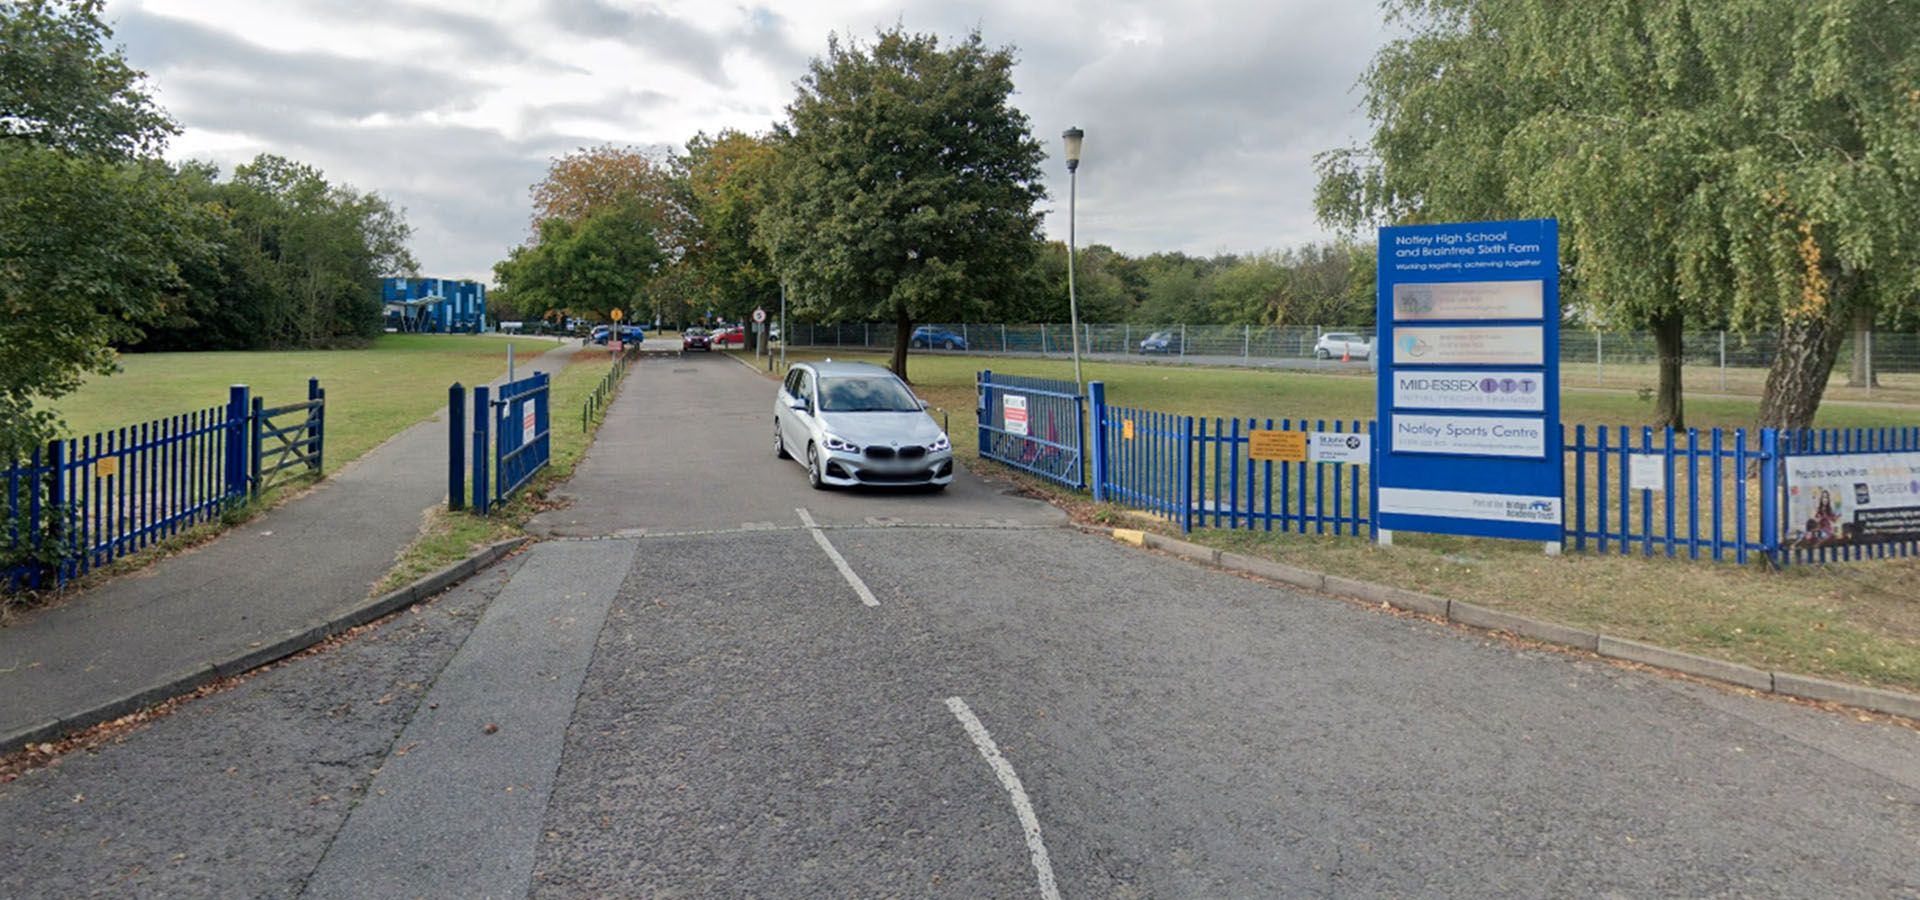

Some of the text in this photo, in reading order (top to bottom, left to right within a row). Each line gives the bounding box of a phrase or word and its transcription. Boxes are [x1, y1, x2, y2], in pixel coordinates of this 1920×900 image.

[1395, 232, 1508, 247] Notley High School
[1395, 243, 1540, 258] and Braintree Sixth Form
[1395, 262, 1427, 272] Working
[1464, 260, 1503, 269] achieving
[1505, 259, 1541, 268] together
[1400, 379, 1479, 391] MID-ESSEX
[1398, 422, 1539, 439] Notley Sports Centre
